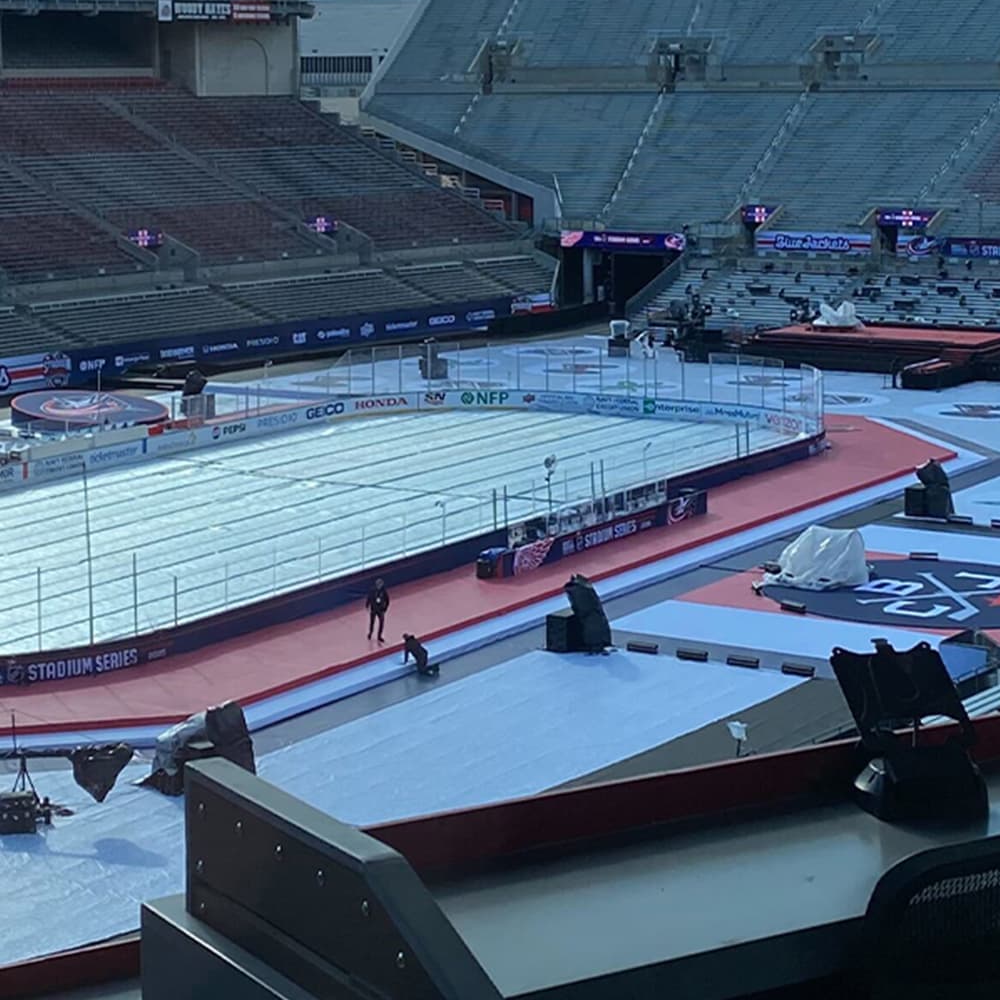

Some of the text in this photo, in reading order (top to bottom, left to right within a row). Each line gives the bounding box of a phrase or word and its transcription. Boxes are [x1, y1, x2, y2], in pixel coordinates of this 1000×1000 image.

[355, 397, 409, 409] HONDA
[477, 391, 509, 405] NFP
[306, 402, 345, 420] GEICO
[223, 423, 246, 435] PEPSI
[28, 657, 93, 681] STADIUM
[95, 649, 138, 672] SERIES
